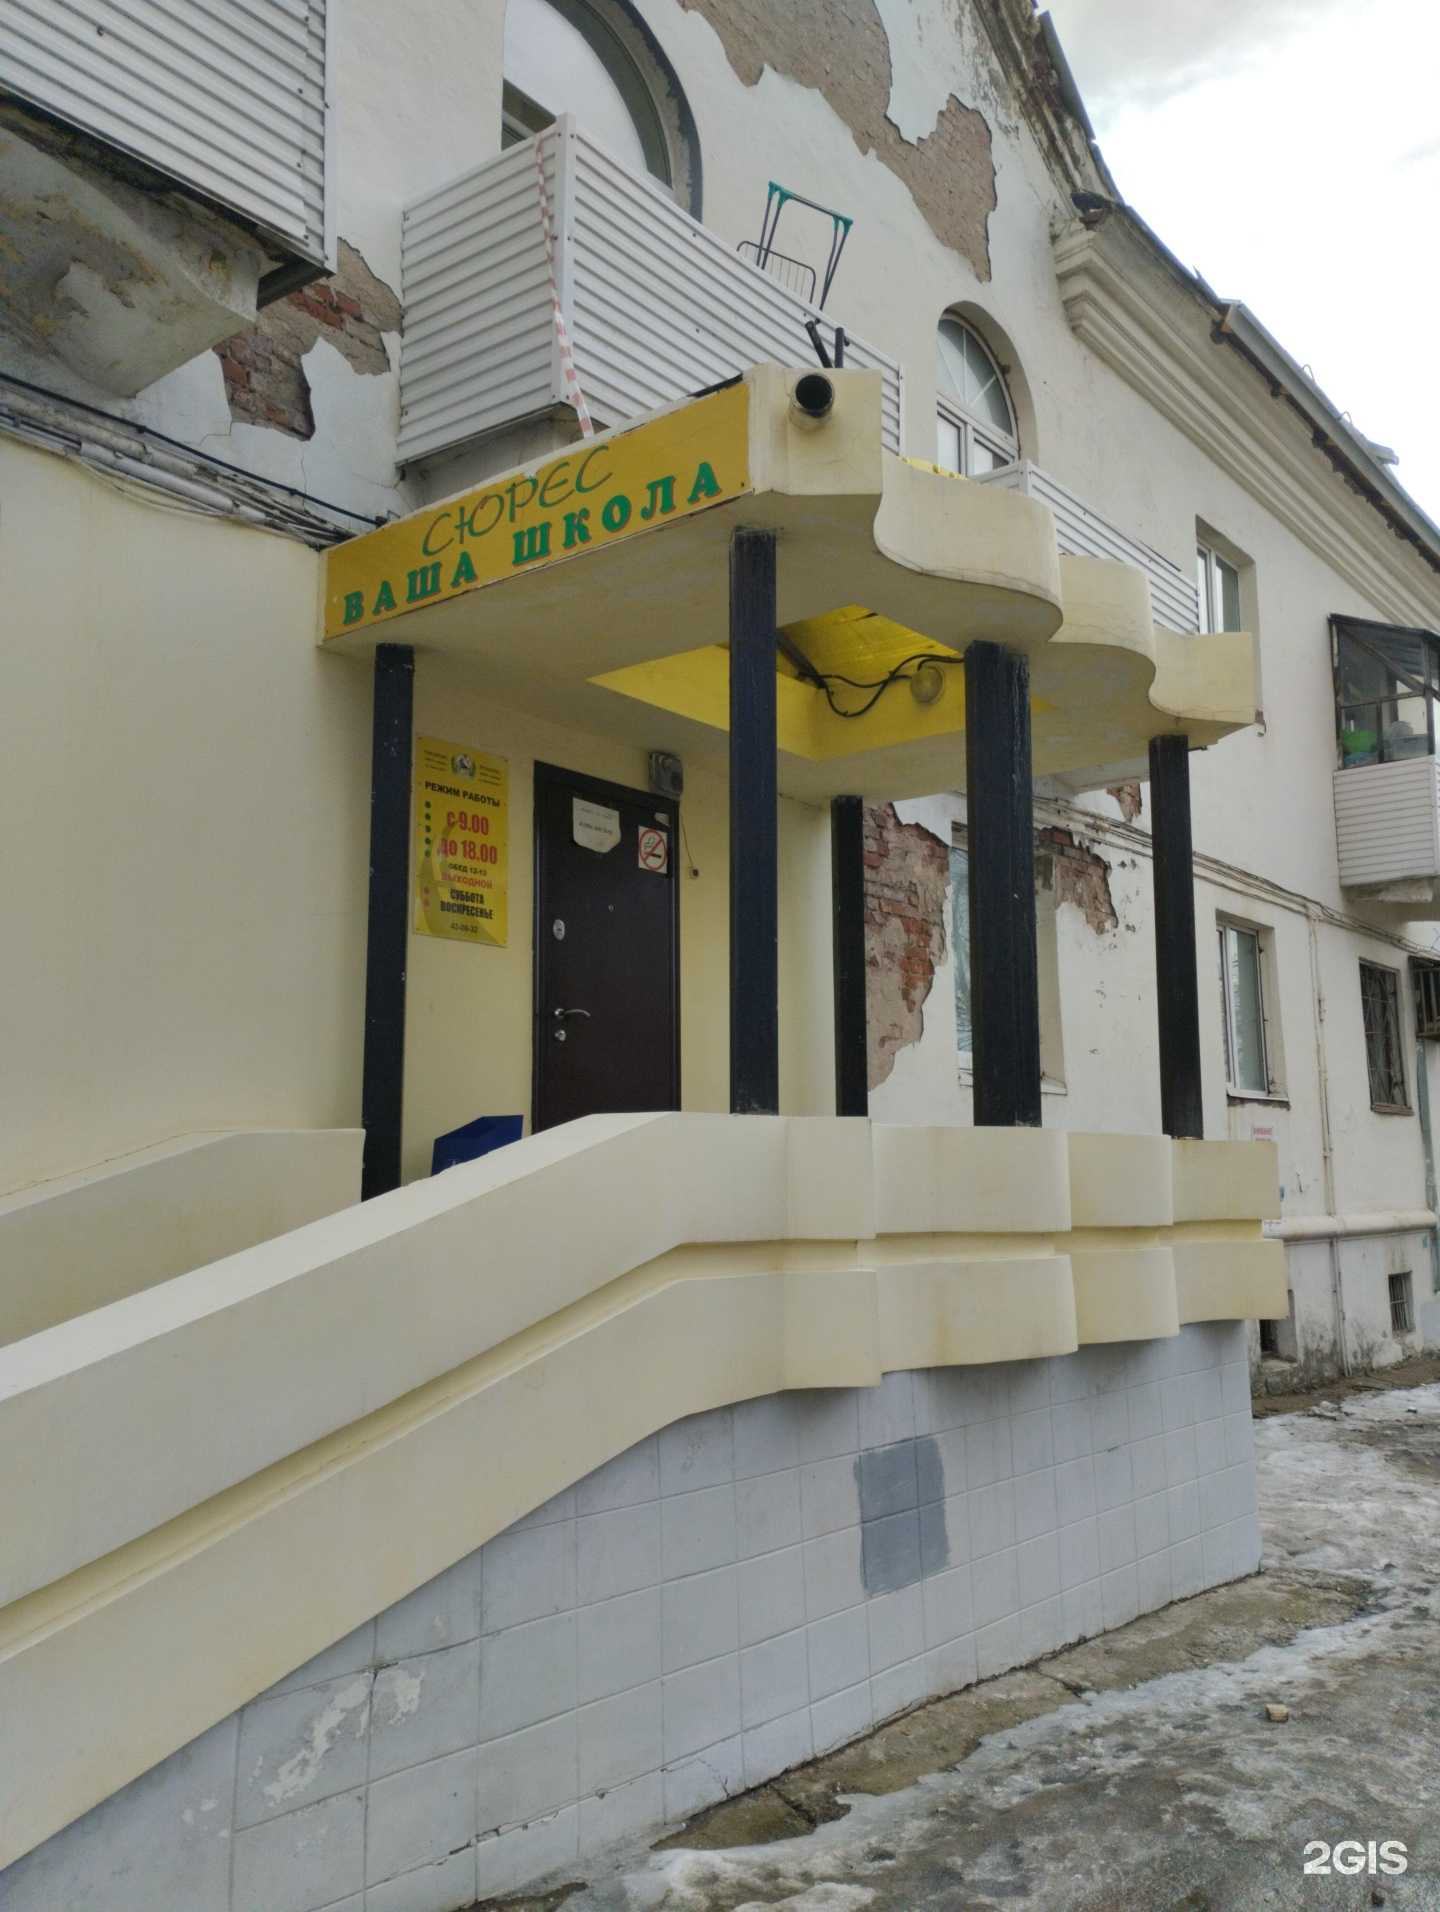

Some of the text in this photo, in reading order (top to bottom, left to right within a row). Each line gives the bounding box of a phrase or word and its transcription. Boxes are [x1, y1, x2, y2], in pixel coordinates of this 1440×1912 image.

[422, 445, 613, 557] СЮРЕС
[342, 461, 722, 625] ВАША ШКОЛА
[424, 780, 500, 808] РЕЖИМ РАБОТЫ
[458, 810, 489, 836] 9.00
[461, 839, 498, 865] 18.00
[449, 888, 485, 905] СУББОТА
[440, 900, 494, 920] ВОСКРЕСЕНЬЕ
